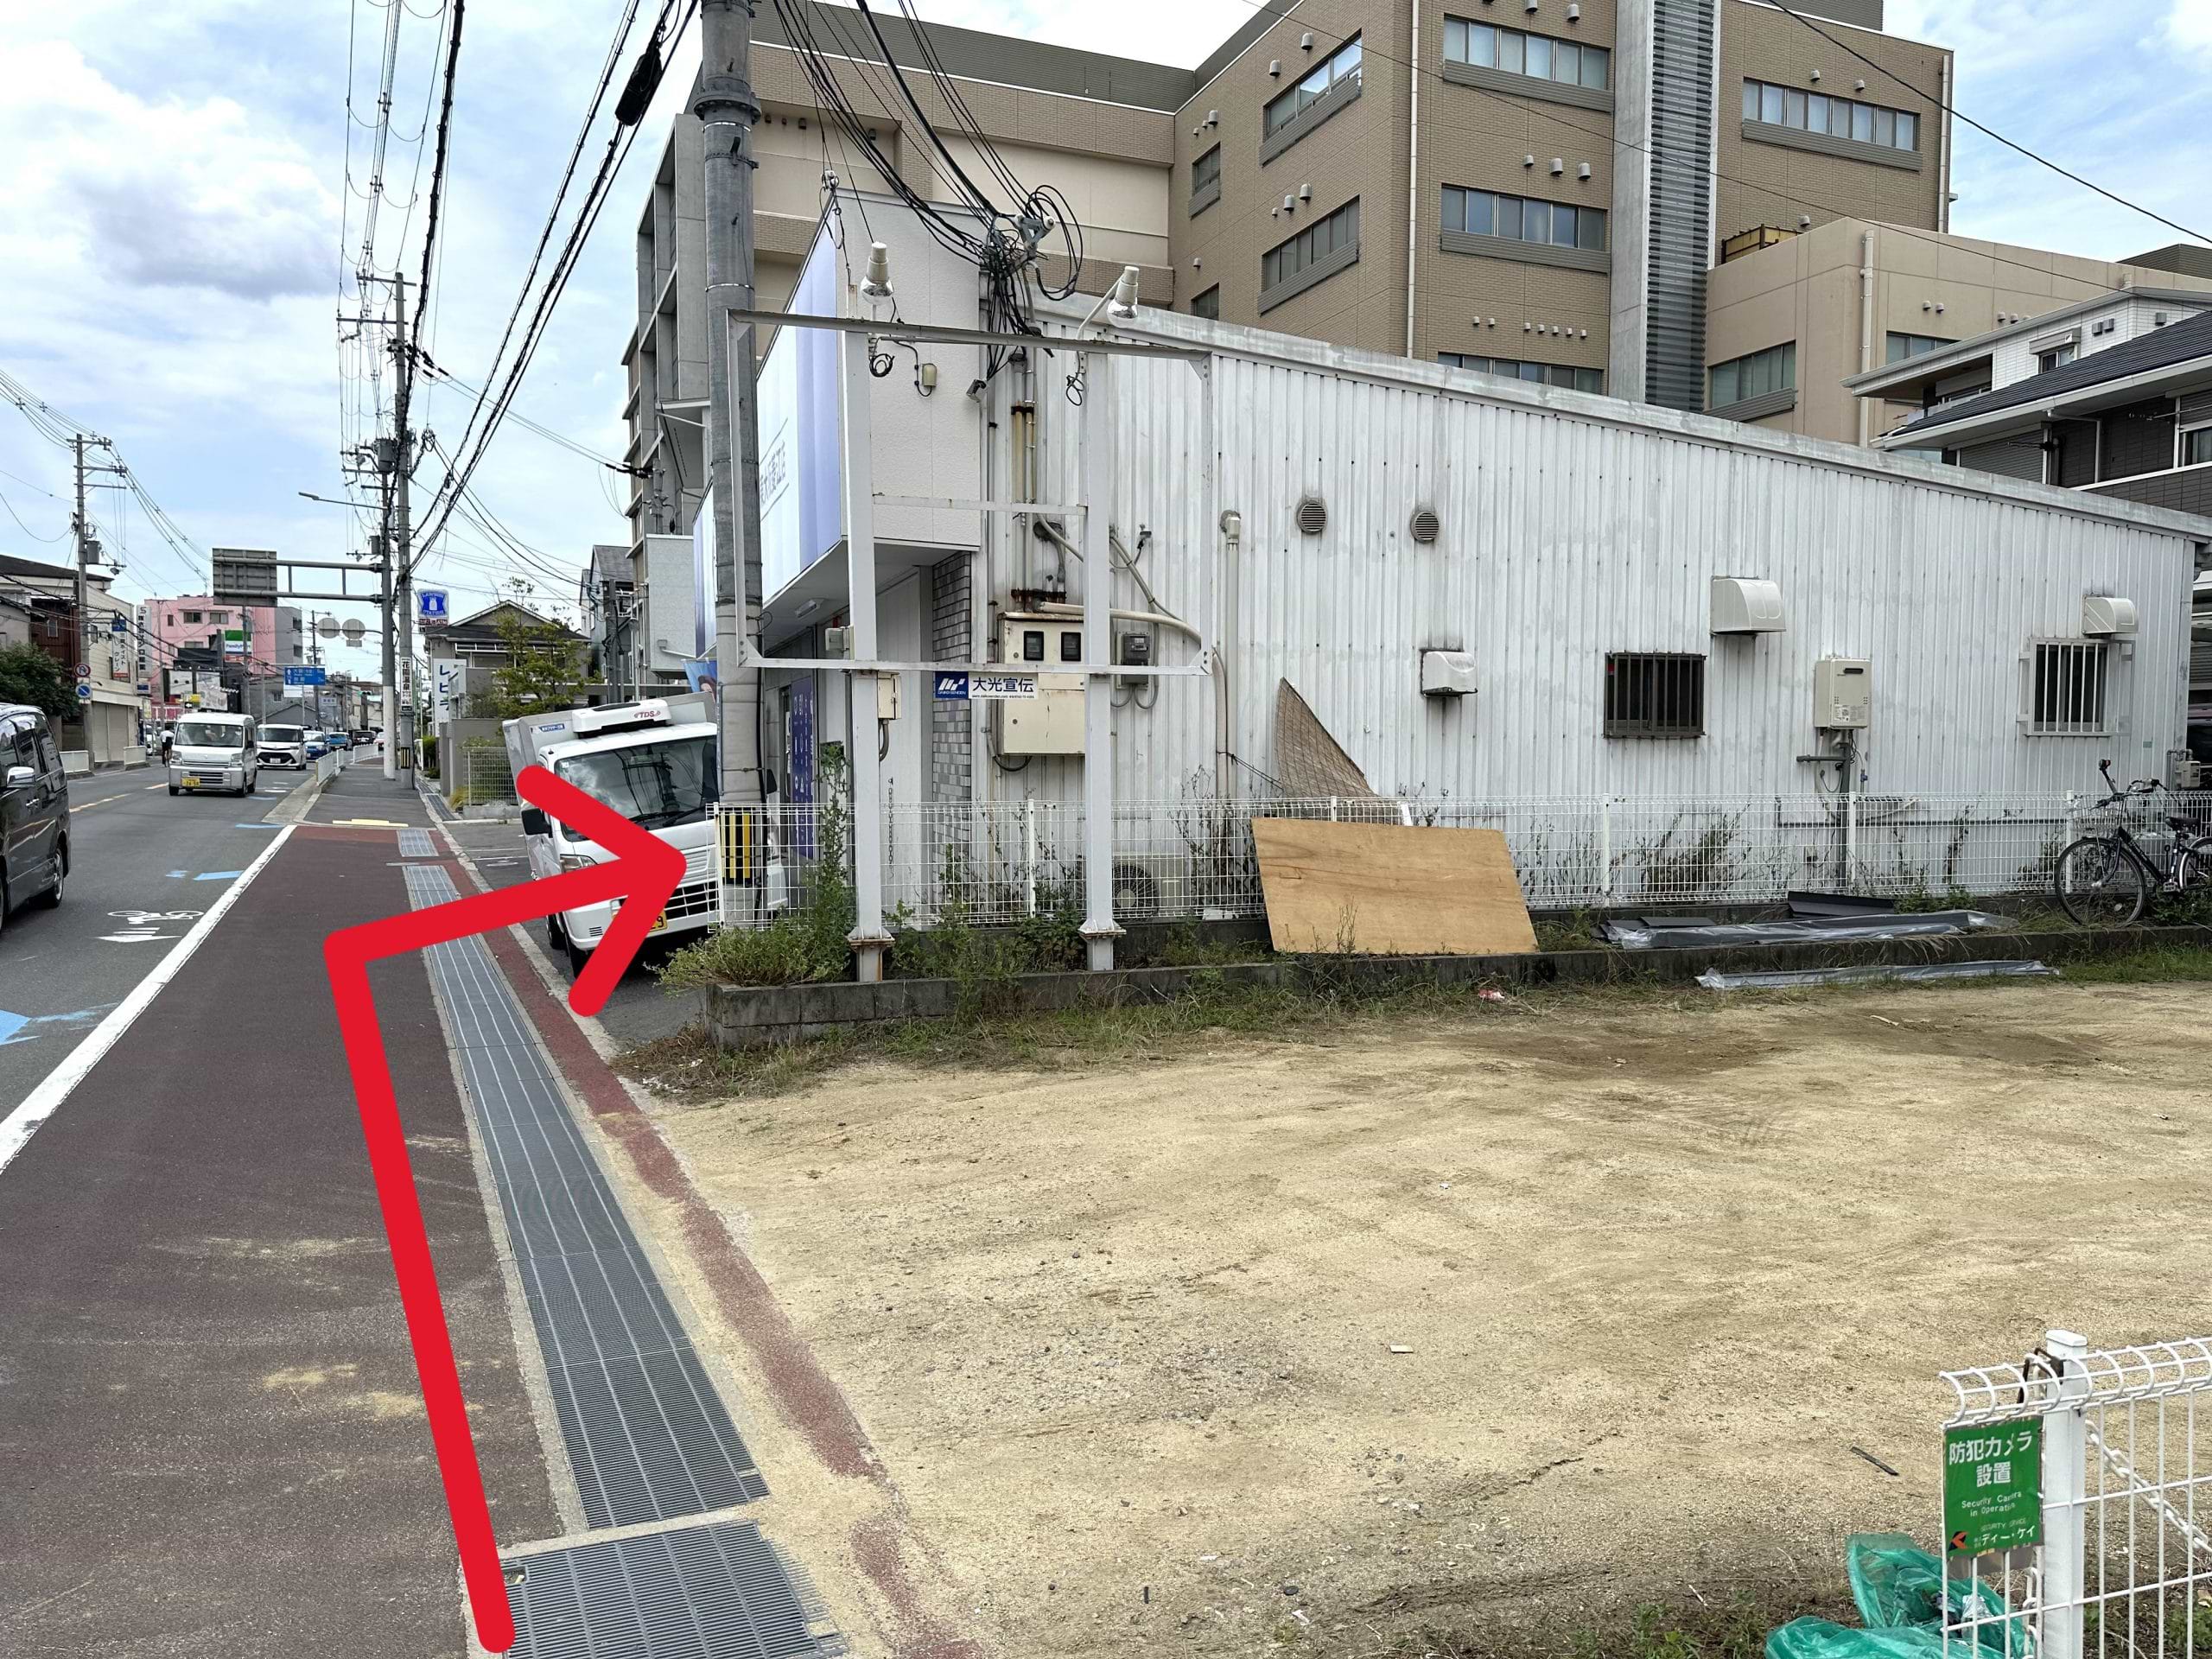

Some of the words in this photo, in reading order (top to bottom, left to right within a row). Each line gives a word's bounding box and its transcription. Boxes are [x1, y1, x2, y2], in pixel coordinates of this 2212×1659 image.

[973, 677, 1034, 692] 大光宣伝
[1948, 1431, 2032, 1465] 防犯カメラ
[1976, 1461, 2012, 1487] 設置
[1961, 1497, 1992, 1509] Security
[1970, 1509, 1978, 1517] in
